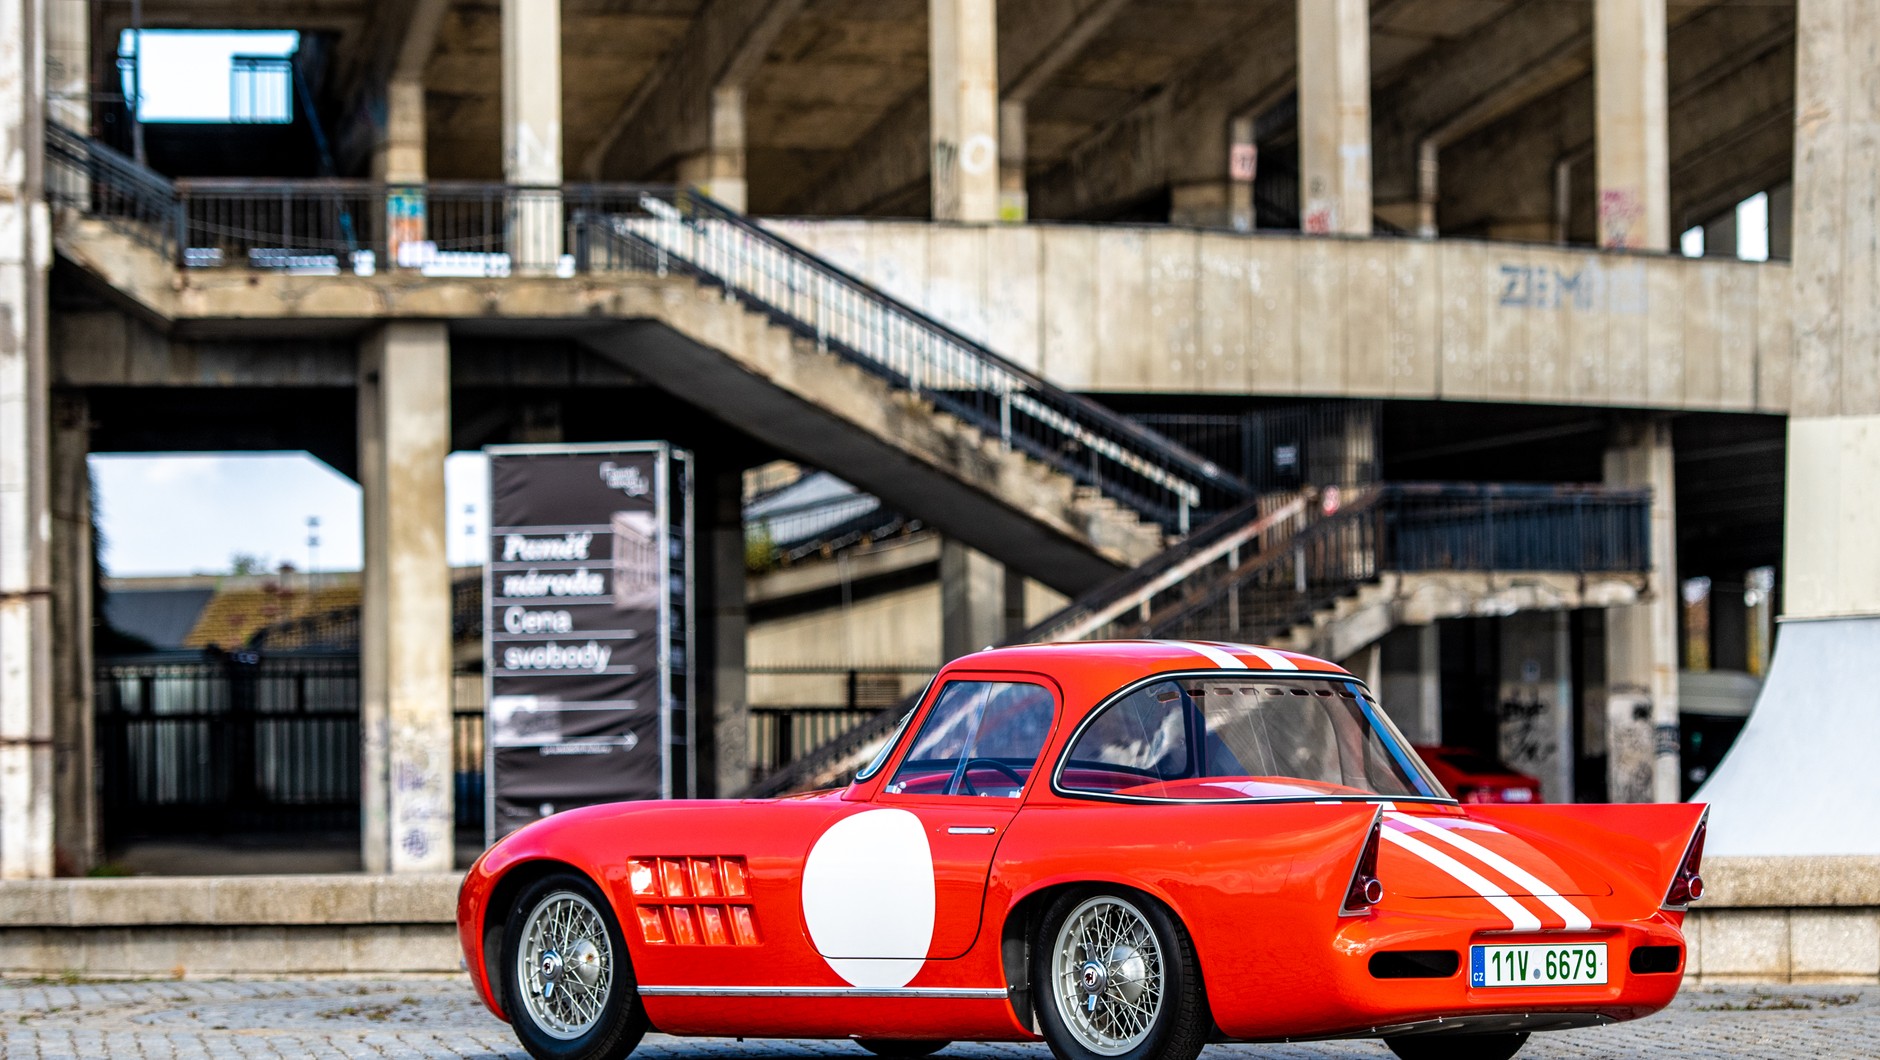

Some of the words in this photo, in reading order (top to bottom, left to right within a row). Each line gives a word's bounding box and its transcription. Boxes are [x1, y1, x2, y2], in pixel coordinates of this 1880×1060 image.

[503, 567, 605, 597] národa
[503, 605, 573, 635] Cena
[503, 640, 612, 673] svobody
[1473, 972, 1484, 982] CZ
[1492, 950, 1529, 981] 11V
[1545, 949, 1597, 980] 6679
